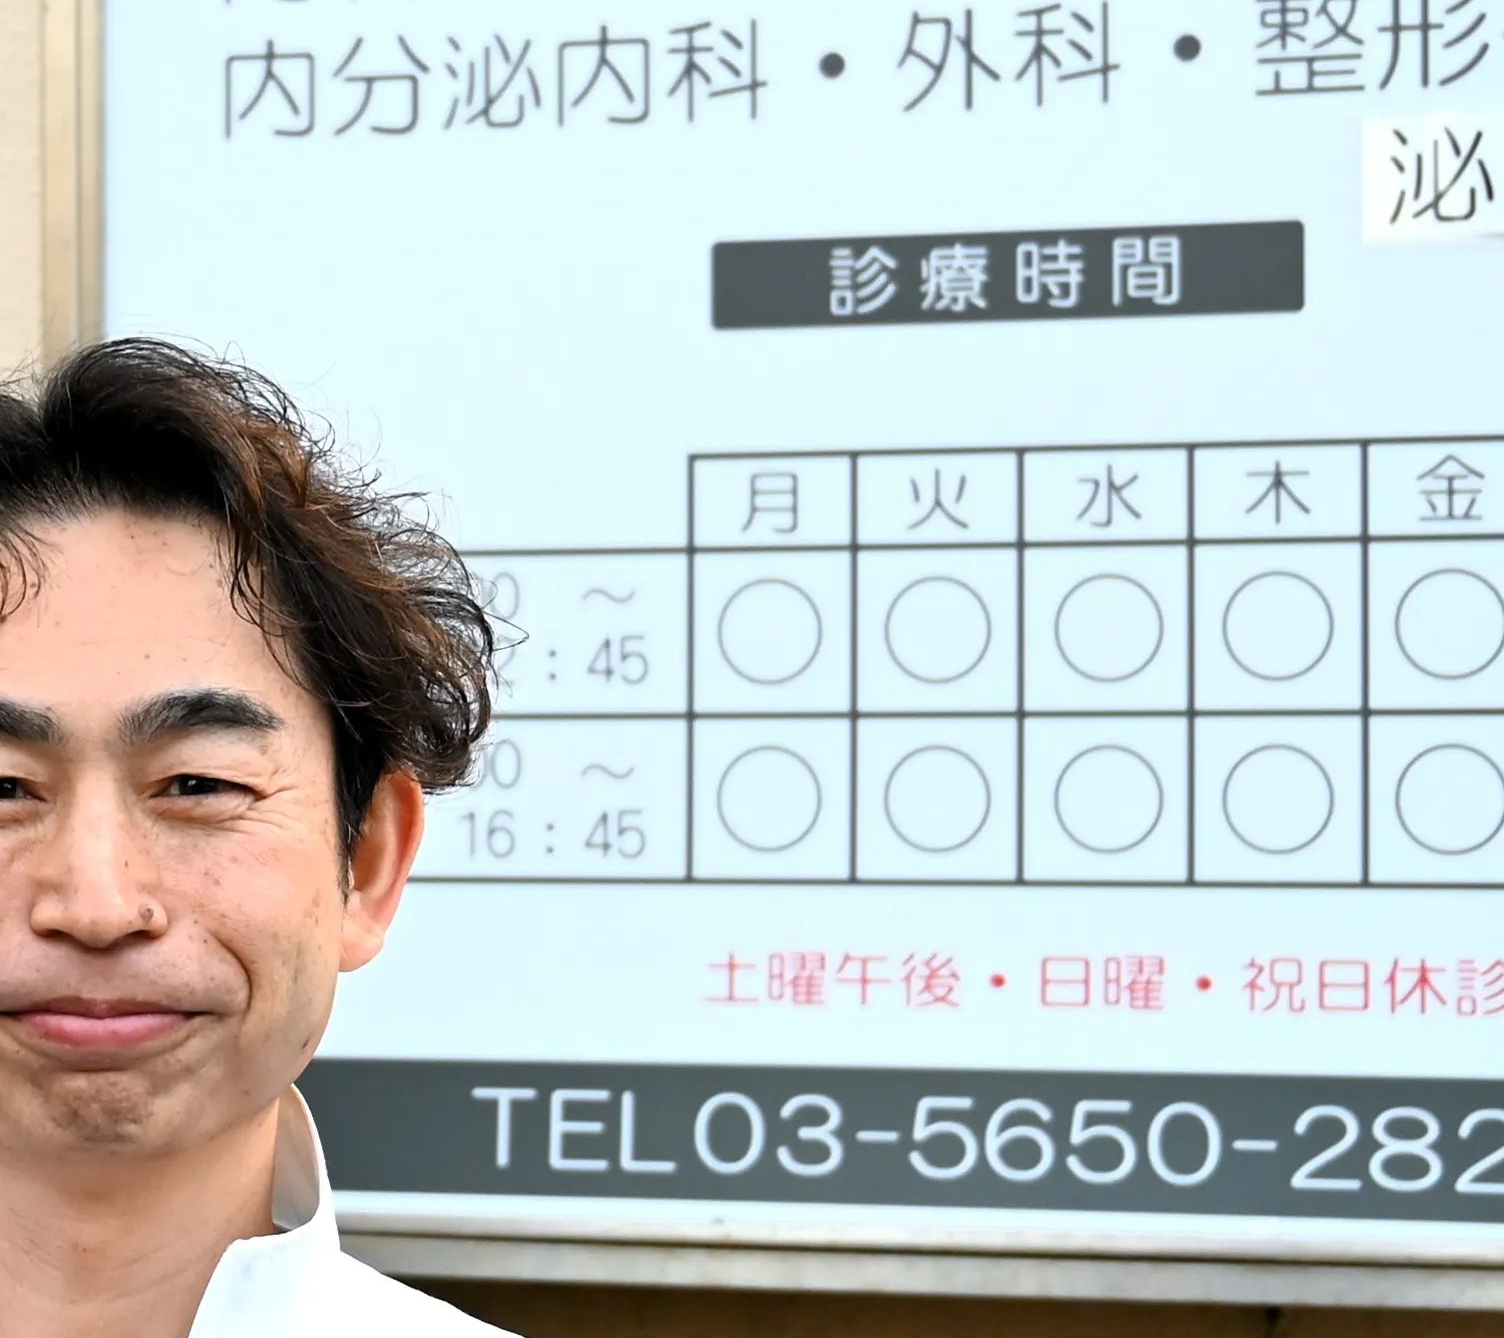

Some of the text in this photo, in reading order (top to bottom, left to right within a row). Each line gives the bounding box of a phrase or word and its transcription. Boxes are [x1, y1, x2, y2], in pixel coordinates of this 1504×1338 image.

[828, 240, 1183, 317] 診療時間
[741, 472, 800, 535] 月
[906, 468, 970, 531] 火
[1076, 464, 1143, 529] 水
[1245, 460, 1312, 526] 木
[1416, 454, 1486, 522] 金
